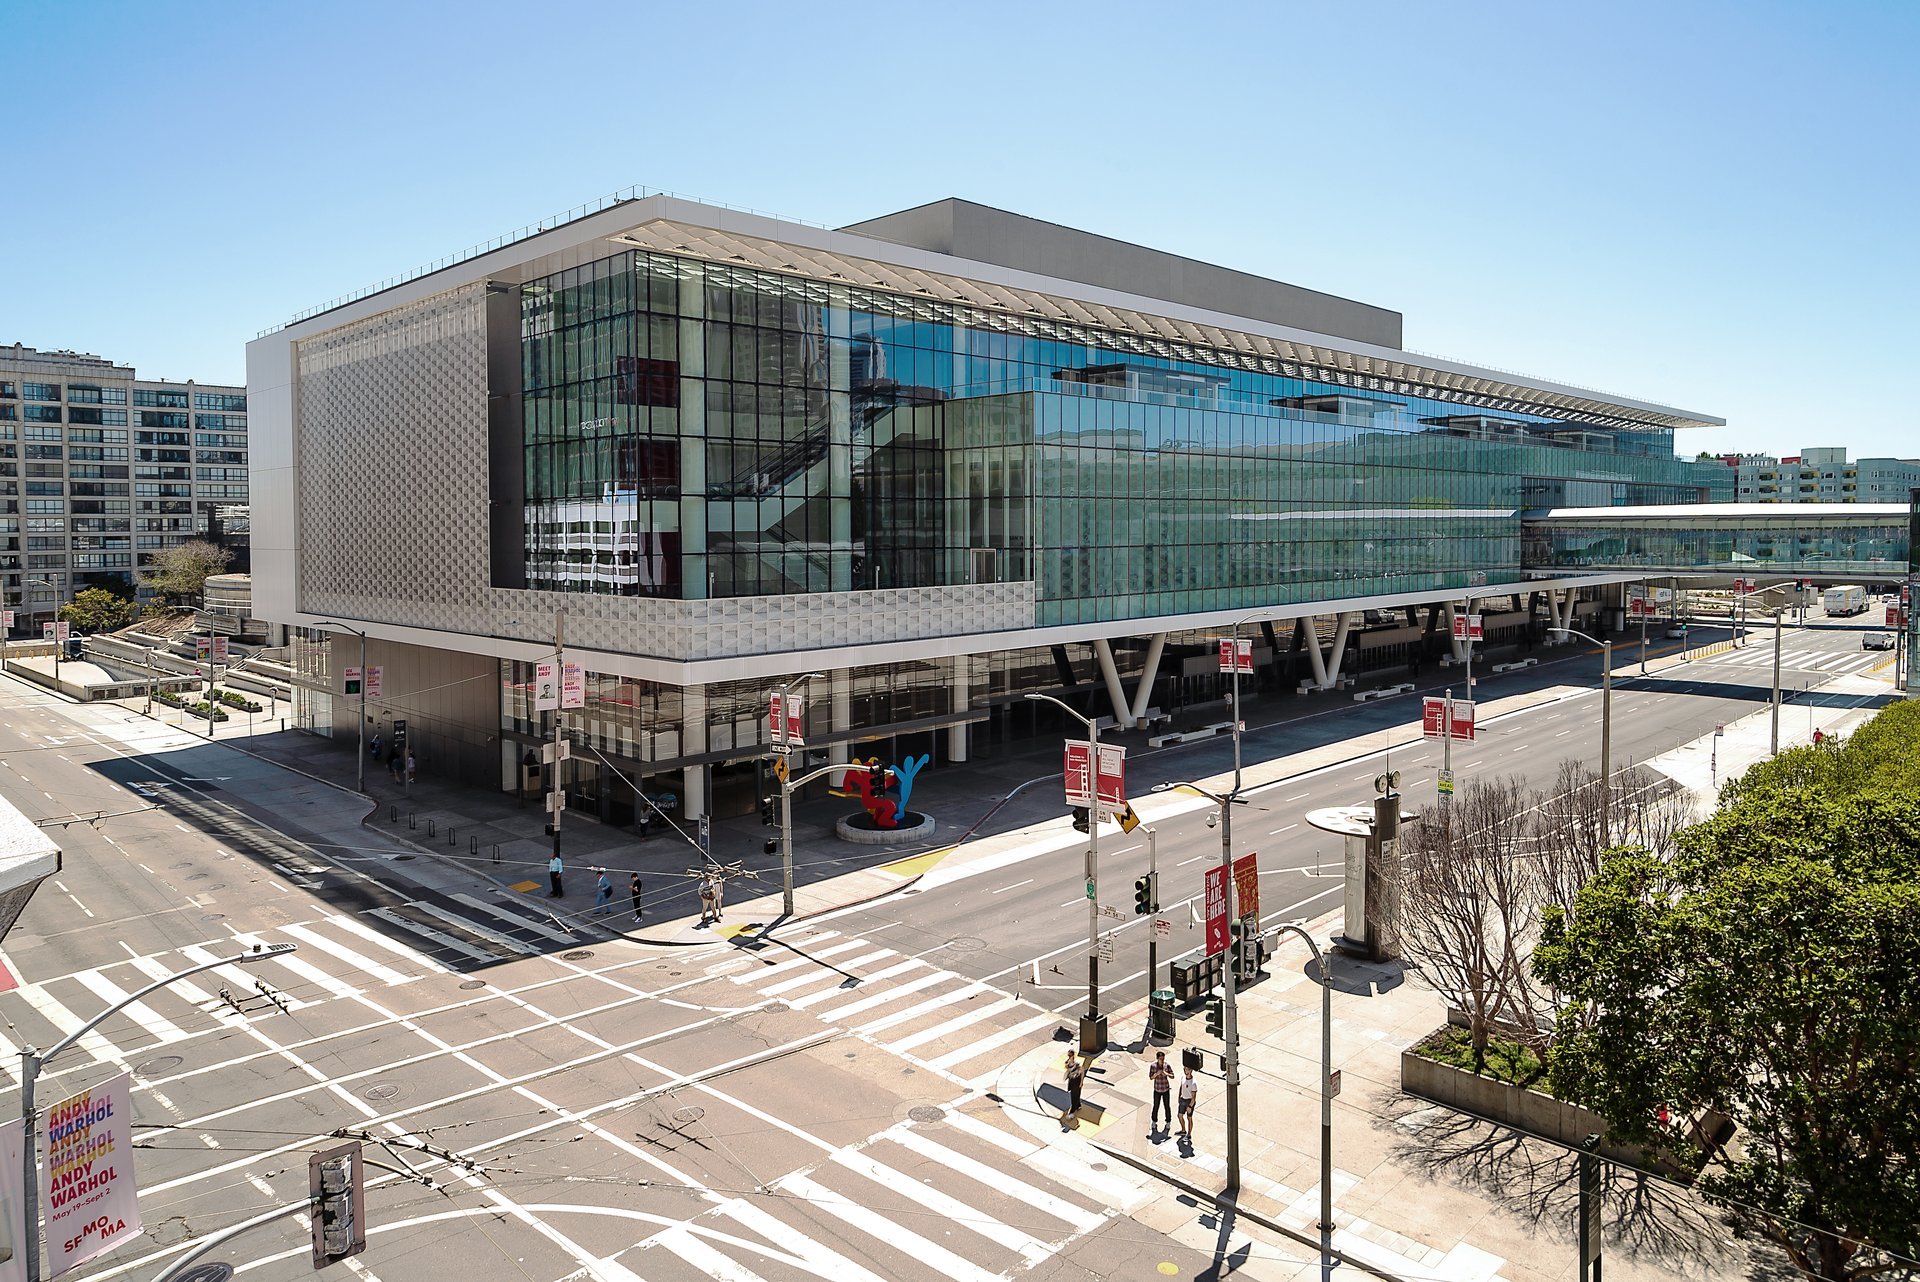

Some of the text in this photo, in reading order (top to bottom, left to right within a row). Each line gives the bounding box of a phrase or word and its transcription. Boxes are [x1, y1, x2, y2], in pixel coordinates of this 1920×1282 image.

[1210, 870, 1222, 888] WE
[1210, 886, 1222, 905] ARE
[1210, 898, 1226, 920] HERE
[49, 1097, 92, 1130] ANDY
[49, 1103, 114, 1144] WARHOL
[49, 1124, 92, 1155] ANDY
[50, 1130, 115, 1171] WARHOL
[50, 1160, 93, 1194] ANDY
[50, 1166, 118, 1210] WARHOL
[52, 1209, 71, 1222] May
[105, 1187, 111, 1195] 2
[64, 1234, 83, 1253] SF
